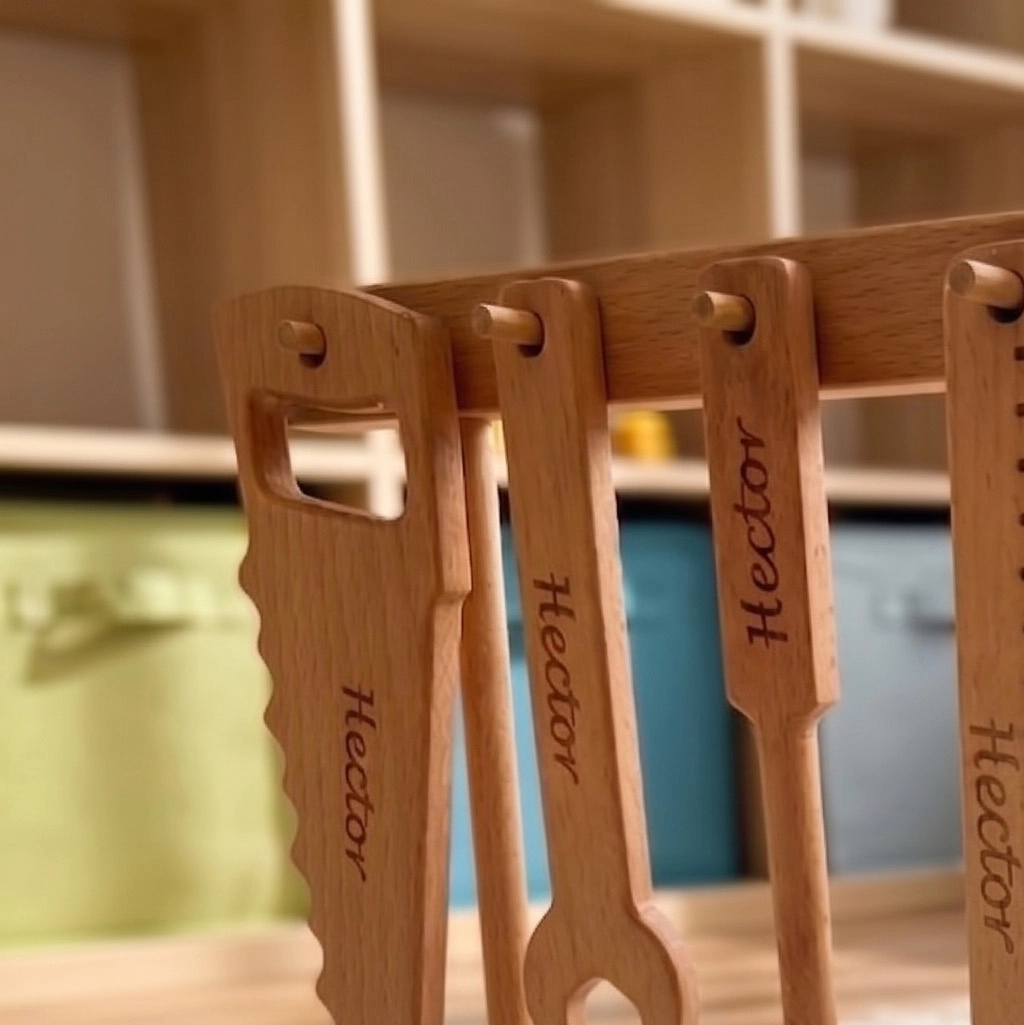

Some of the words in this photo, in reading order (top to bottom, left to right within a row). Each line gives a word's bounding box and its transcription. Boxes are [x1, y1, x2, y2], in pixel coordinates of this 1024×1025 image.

[733, 416, 788, 649] Hector
[342, 684, 376, 882] Hector
[533, 572, 580, 785] Hector
[969, 718, 1022, 954] Hector
